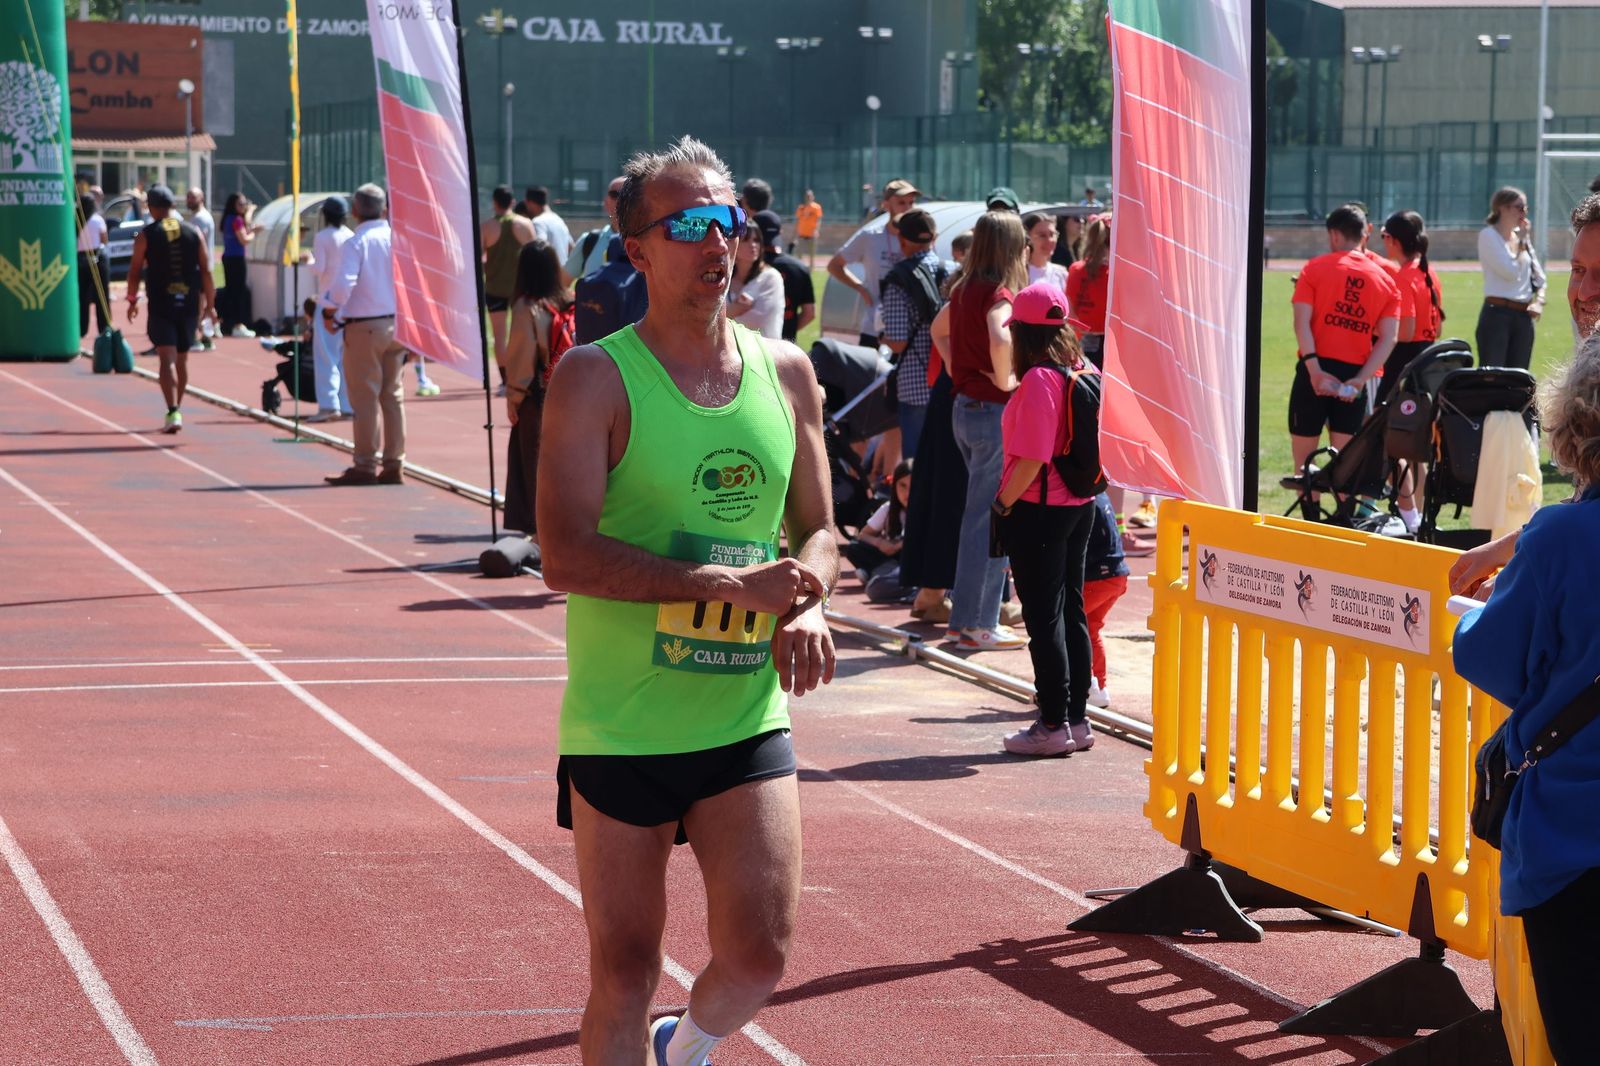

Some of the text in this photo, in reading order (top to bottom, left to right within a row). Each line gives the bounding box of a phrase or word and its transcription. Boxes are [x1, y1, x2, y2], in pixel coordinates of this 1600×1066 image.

[523, 17, 733, 45] CAJA RURAL
[23, 192, 66, 205] RURAL
[1346, 276, 1365, 290] NO
[1345, 290, 1360, 303] ES
[1324, 314, 1370, 334] CORRER
[709, 553, 733, 565] CAJA
[1227, 562, 1284, 584] FEDERACIÓN DE ATLETISMO
[1228, 575, 1234, 585] DE
[1237, 577, 1261, 591] CASTILLA
[1256, 596, 1262, 605] DE
[1263, 598, 1281, 609] ZAMORA
[1331, 584, 1394, 608] FEDERACIÓN DE ATLETISMO
[1331, 598, 1338, 609] DE
[1341, 600, 1368, 616] CASTILLA
[1363, 621, 1370, 630] DE
[1371, 622, 1391, 635] ZAMORA
[693, 650, 766, 665] CAJA RURAL
